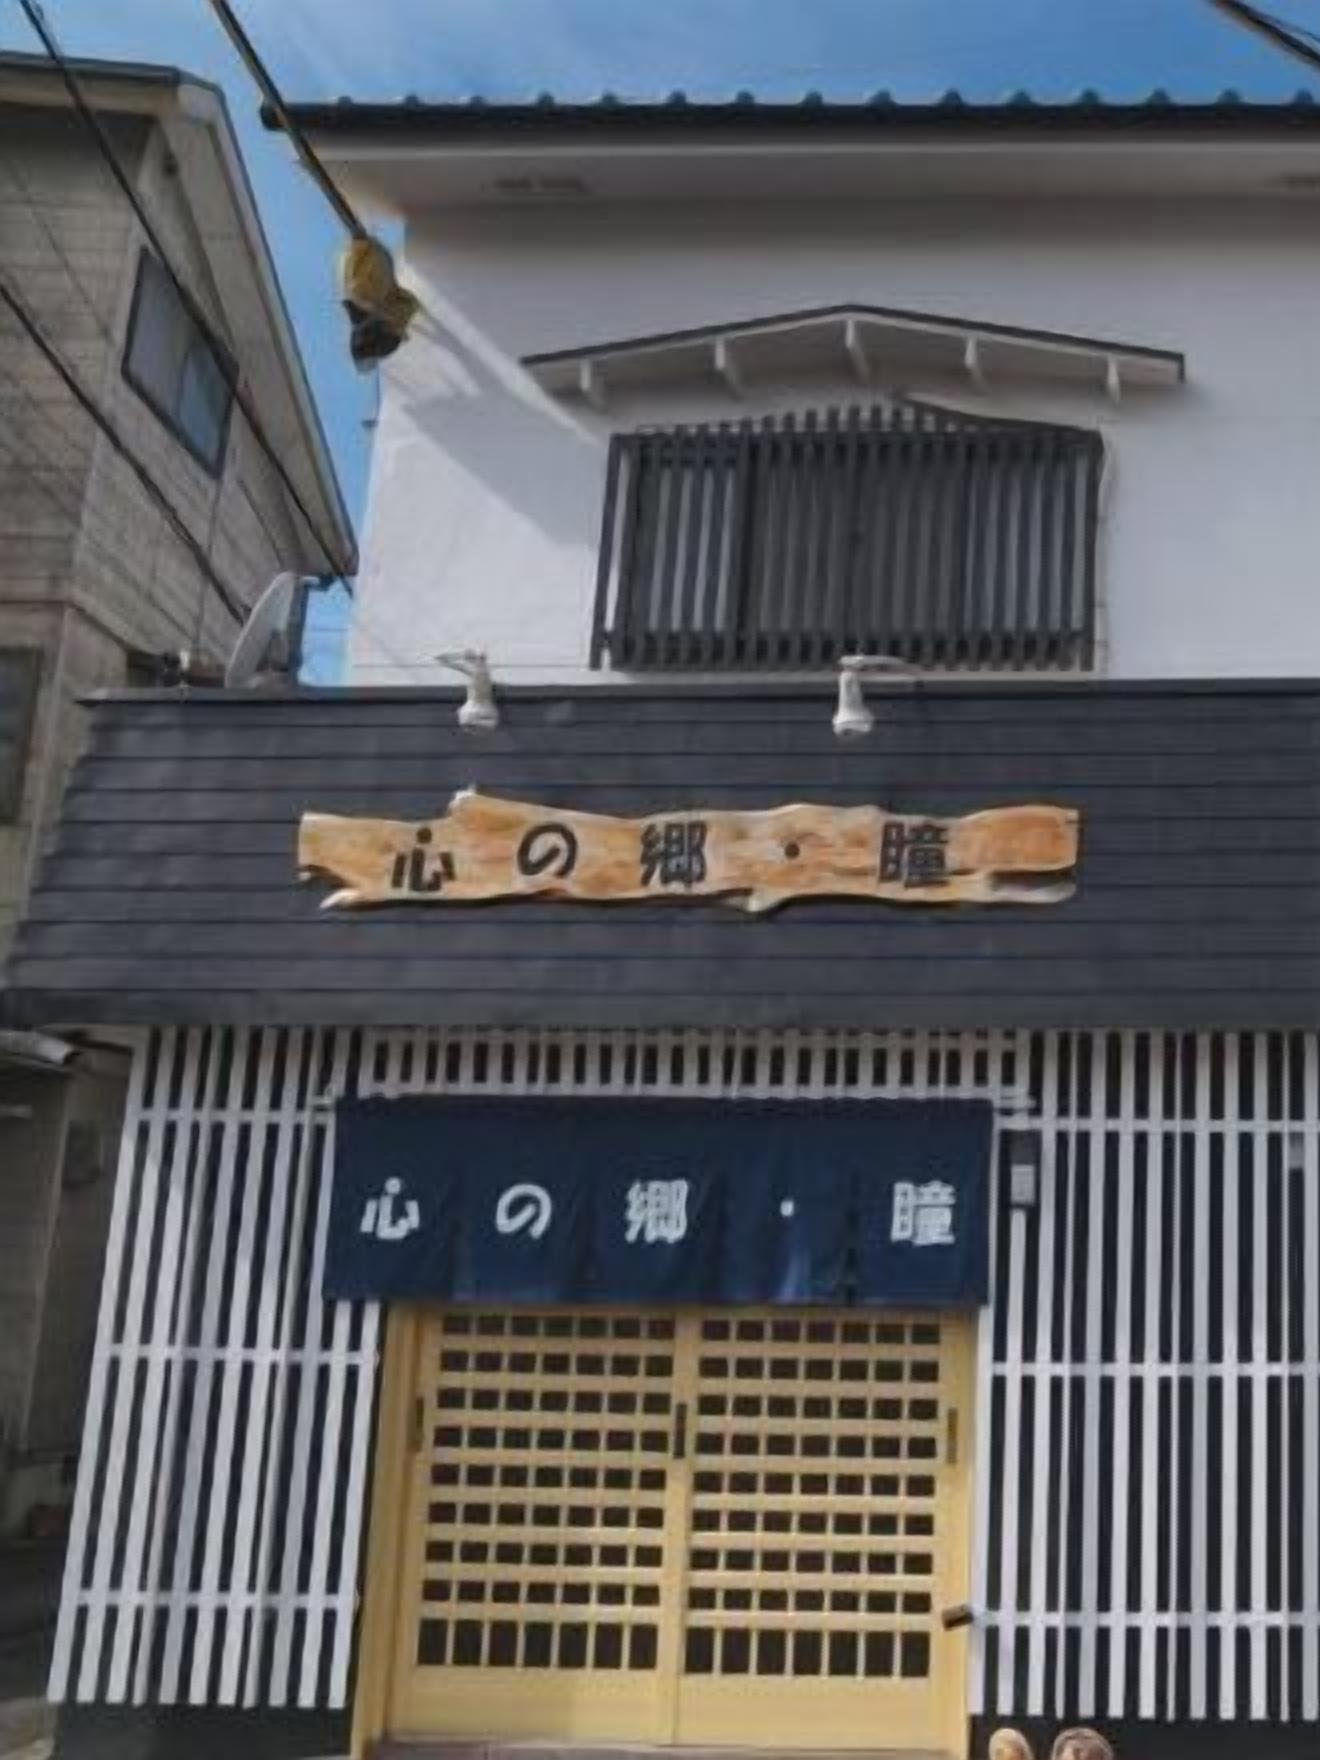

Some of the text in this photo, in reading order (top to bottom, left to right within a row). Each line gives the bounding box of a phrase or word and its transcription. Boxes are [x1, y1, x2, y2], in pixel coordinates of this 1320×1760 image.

[391, 819, 950, 892] 心の郷・瞳
[360, 1177, 957, 1246] 心の郷・瞳
